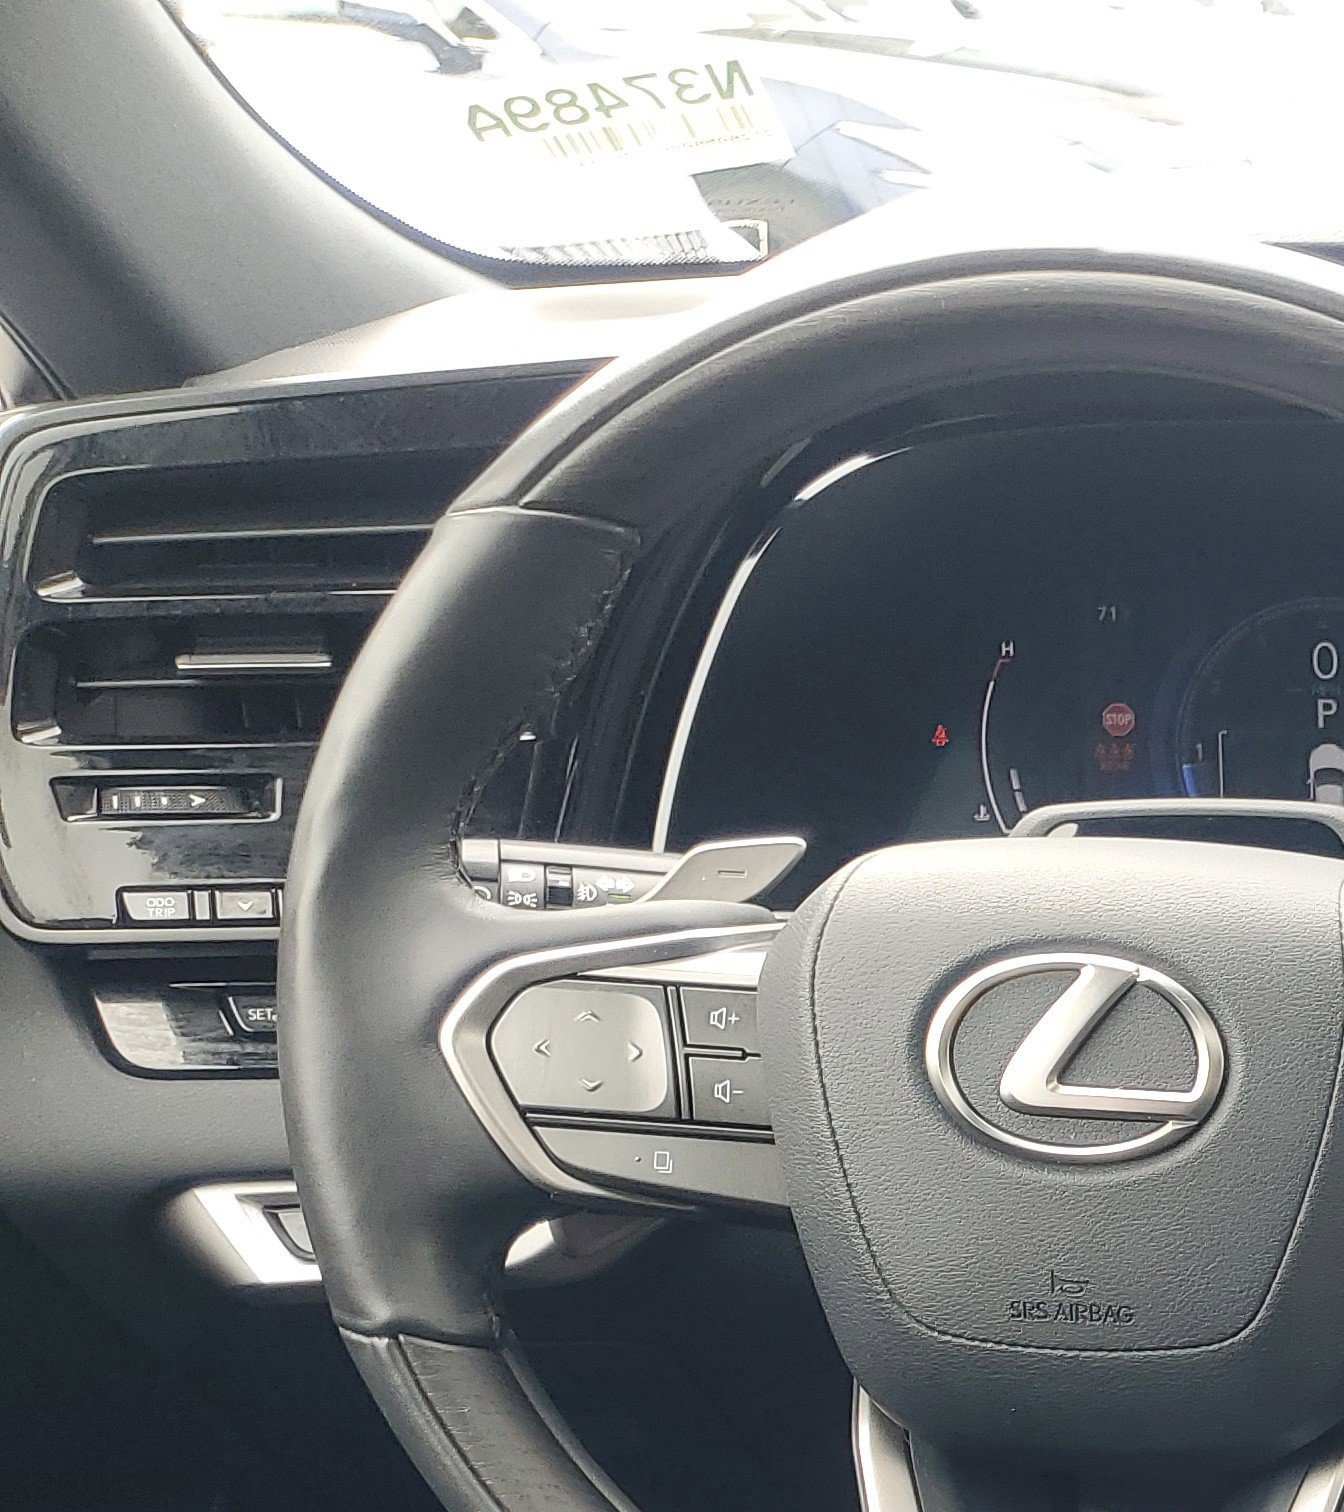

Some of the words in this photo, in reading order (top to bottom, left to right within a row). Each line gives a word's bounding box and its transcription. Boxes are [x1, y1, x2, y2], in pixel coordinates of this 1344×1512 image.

[1097, 605, 1118, 622] 71
[1001, 641, 1014, 657] H
[1317, 699, 1338, 728] P
[147, 897, 175, 908] ODO
[148, 908, 176, 918] TRIP
[1009, 1300, 1050, 1321] SRS
[1053, 1302, 1136, 1325] AIRBAG
